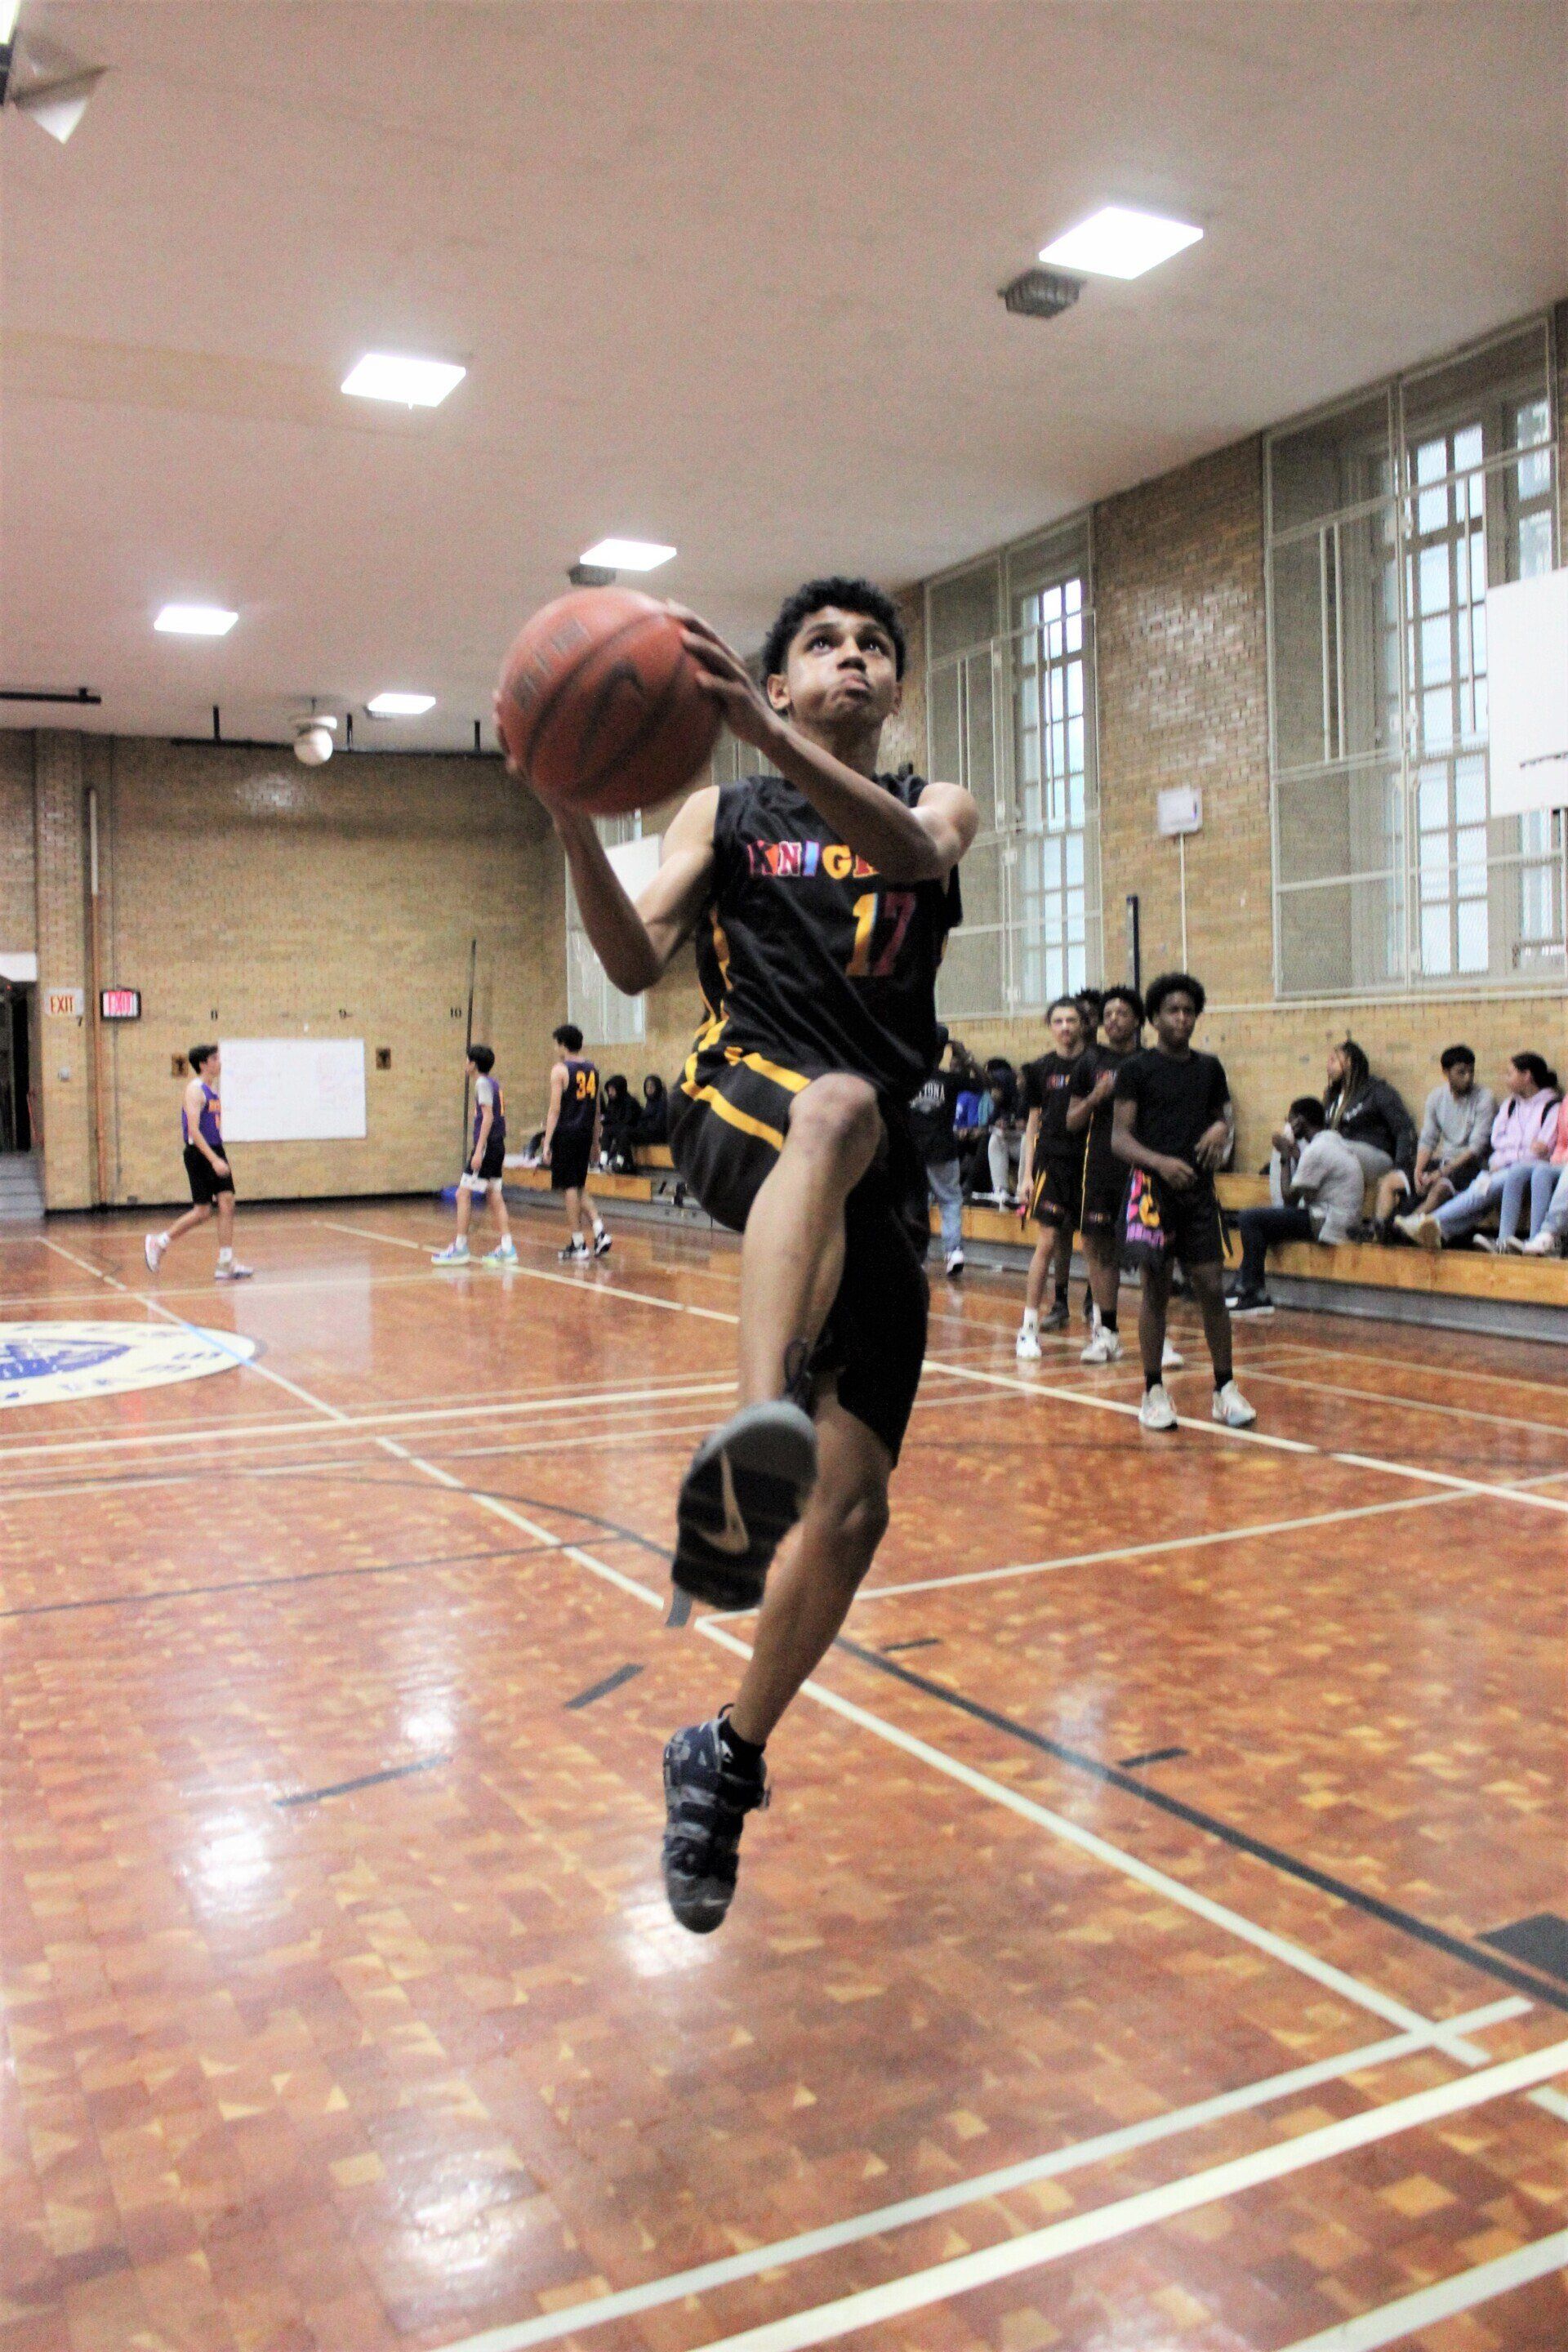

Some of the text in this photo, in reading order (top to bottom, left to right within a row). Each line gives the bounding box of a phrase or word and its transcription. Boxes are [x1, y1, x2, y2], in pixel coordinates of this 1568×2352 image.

[845, 892, 916, 977] 17
[50, 994, 75, 1013] EXIT
[108, 990, 133, 1016] EXIT
[575, 1069, 596, 1101] 34
